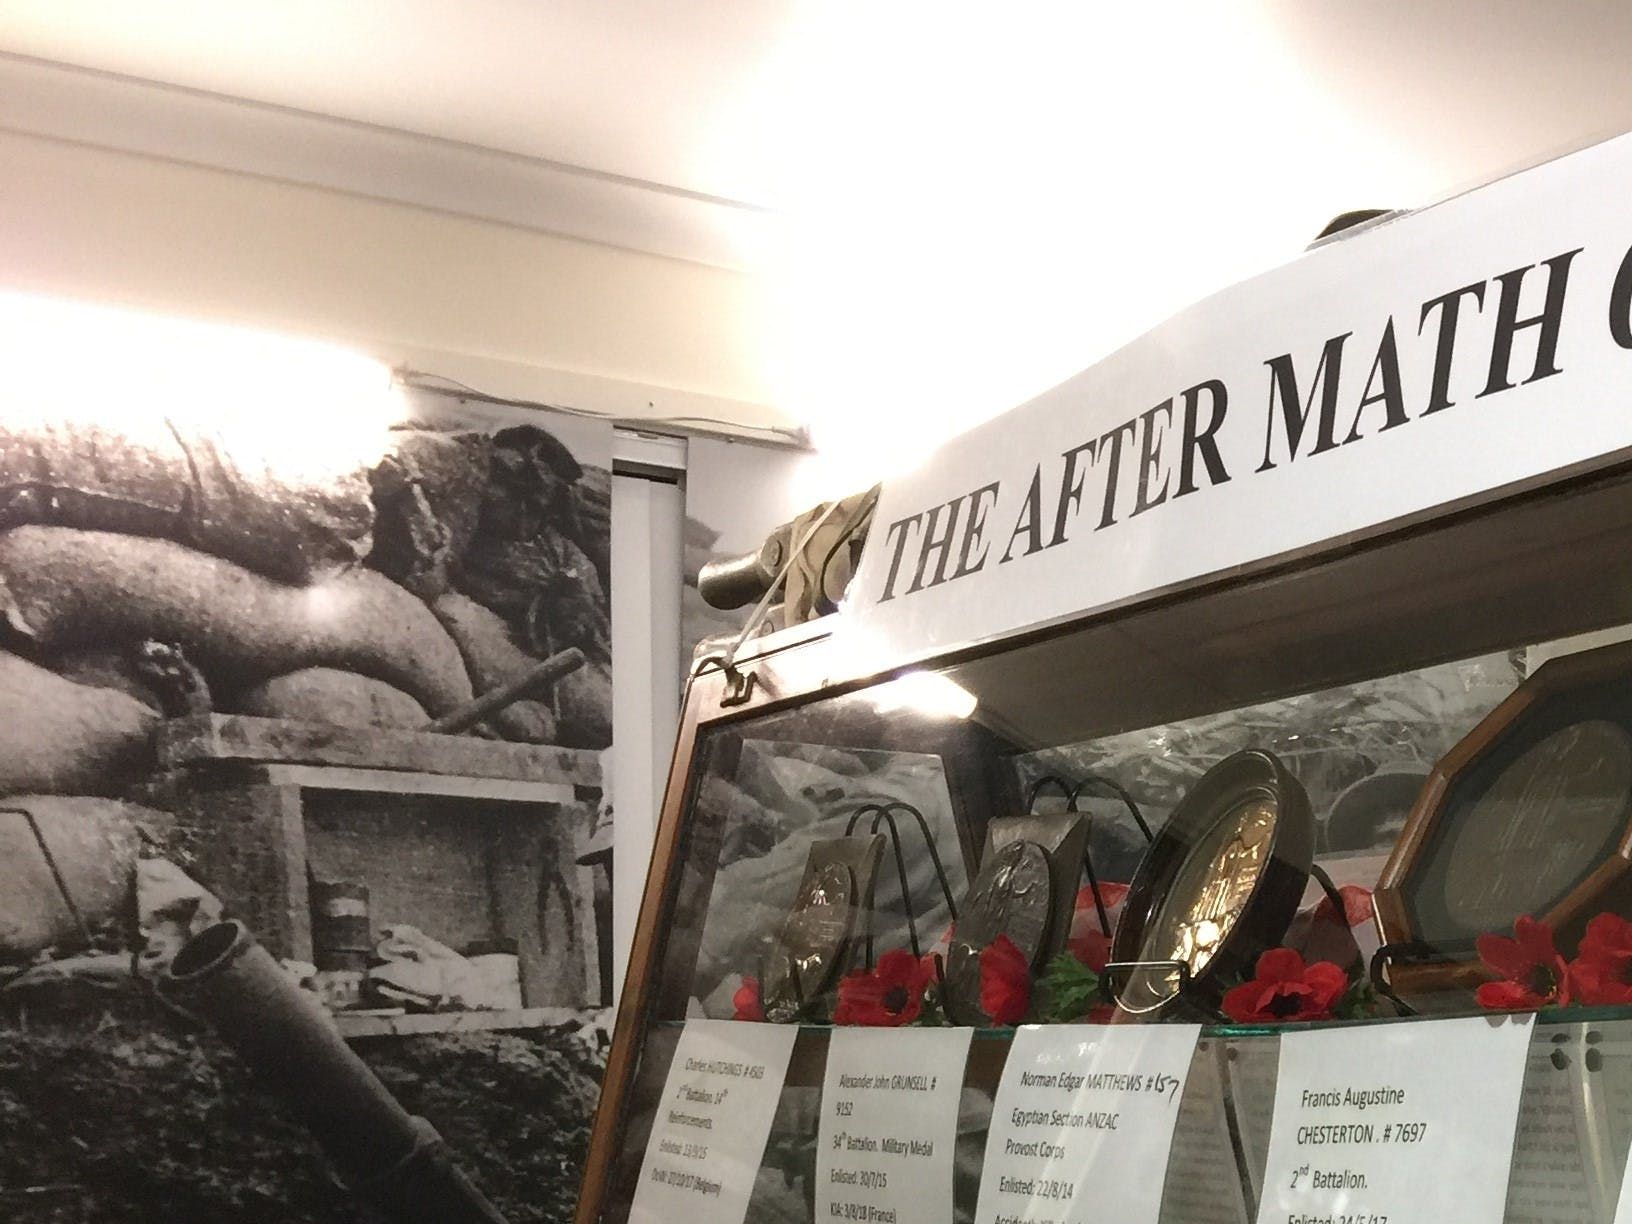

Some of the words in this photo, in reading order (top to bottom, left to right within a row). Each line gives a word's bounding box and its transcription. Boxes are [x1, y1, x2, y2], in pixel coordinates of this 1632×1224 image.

[878, 480, 1001, 604] THE
[999, 380, 1231, 565] AFTER
[1258, 248, 1584, 469] MATH
[1020, 1072, 1057, 1087] Norman
[1058, 1072, 1085, 1092] Edgar
[1088, 1074, 1143, 1091] MATTHEWS
[1302, 1089, 1340, 1108] Francis
[1343, 1087, 1404, 1109] Augustine
[1012, 1108, 1049, 1127] Egyptian
[1050, 1110, 1083, 1127] Section
[1085, 1113, 1119, 1129] ANZAC
[1297, 1124, 1374, 1144] CHESTERTON
[1383, 1125, 1391, 1142] #
[1395, 1123, 1426, 1143] 7697
[1005, 1139, 1038, 1156] Provost
[1040, 1141, 1065, 1159] Corps
[1000, 1176, 1035, 1194] Enlisted:
[1037, 1181, 1073, 1200] 22/8/14
[1313, 1171, 1367, 1190] Battalion.
